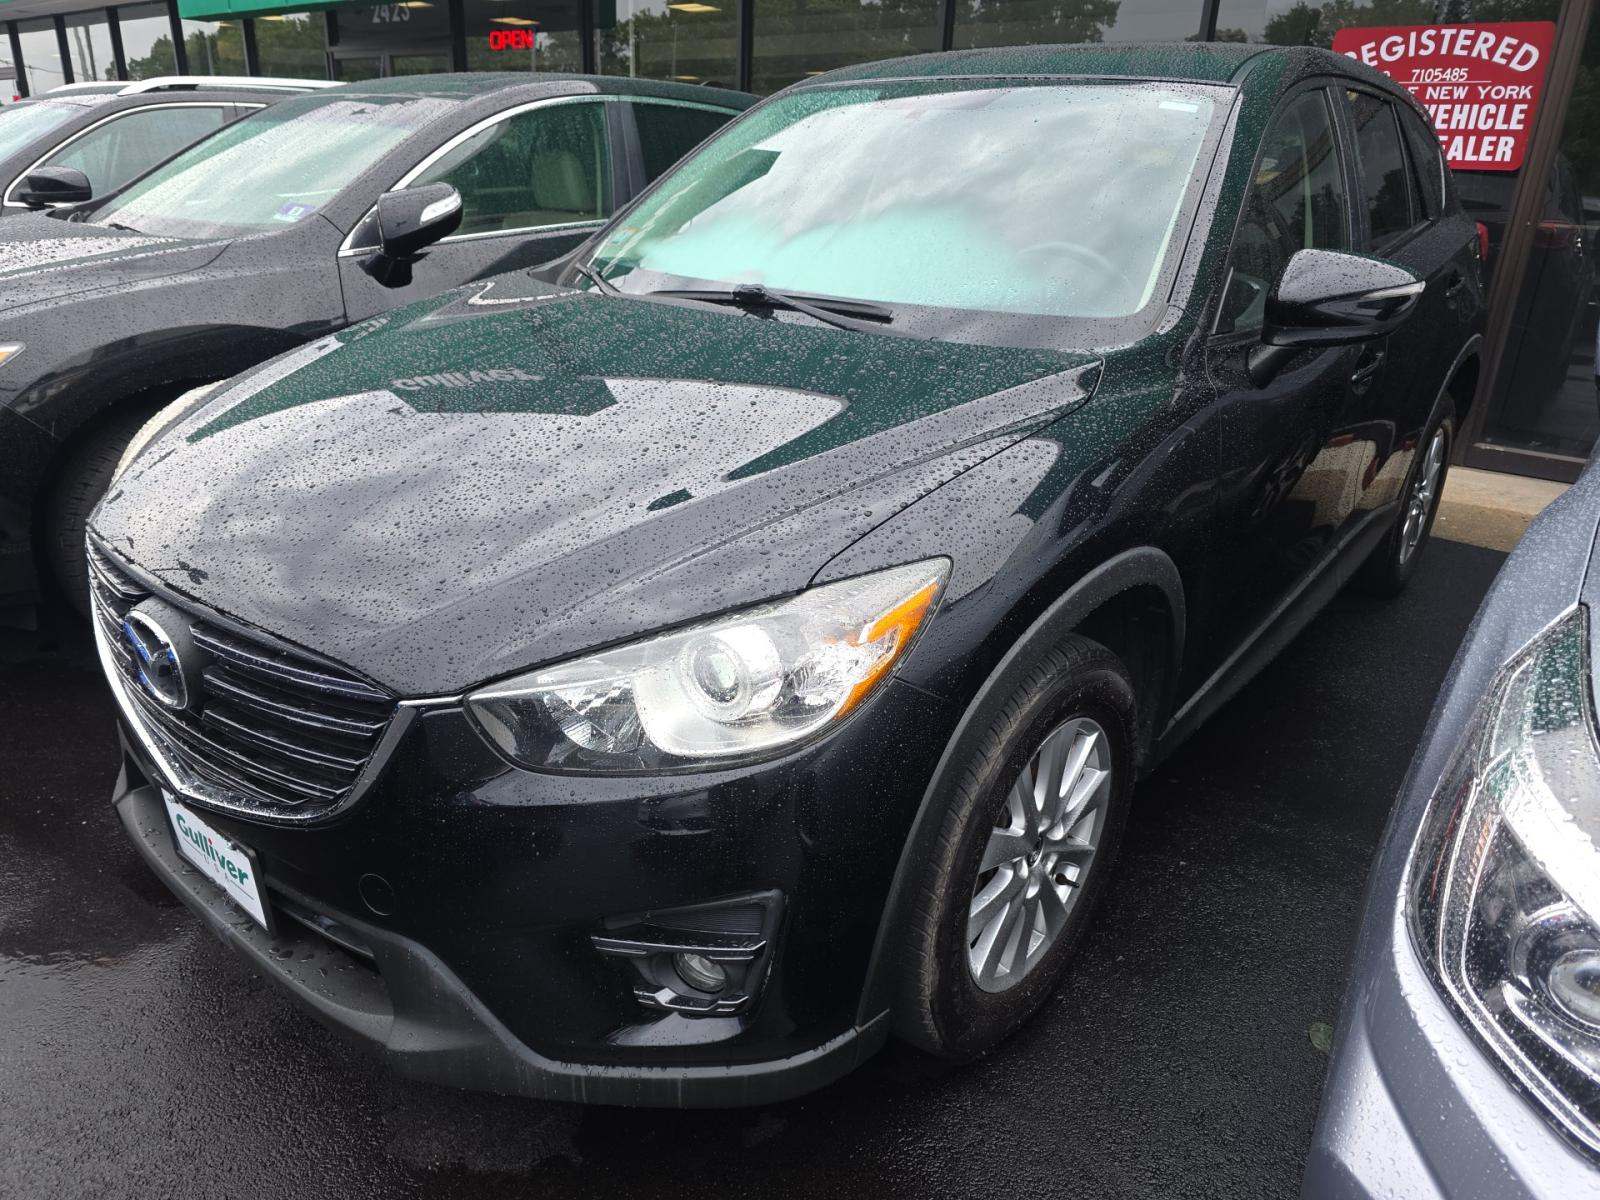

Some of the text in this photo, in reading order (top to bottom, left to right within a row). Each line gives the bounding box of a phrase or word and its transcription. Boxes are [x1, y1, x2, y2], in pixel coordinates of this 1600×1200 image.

[489, 29, 535, 50] OPEN
[1411, 68, 1469, 82] 7105485
[1426, 86, 1468, 99] NEW
[1478, 85, 1533, 99] YORK
[176, 813, 249, 886] Gulliver
